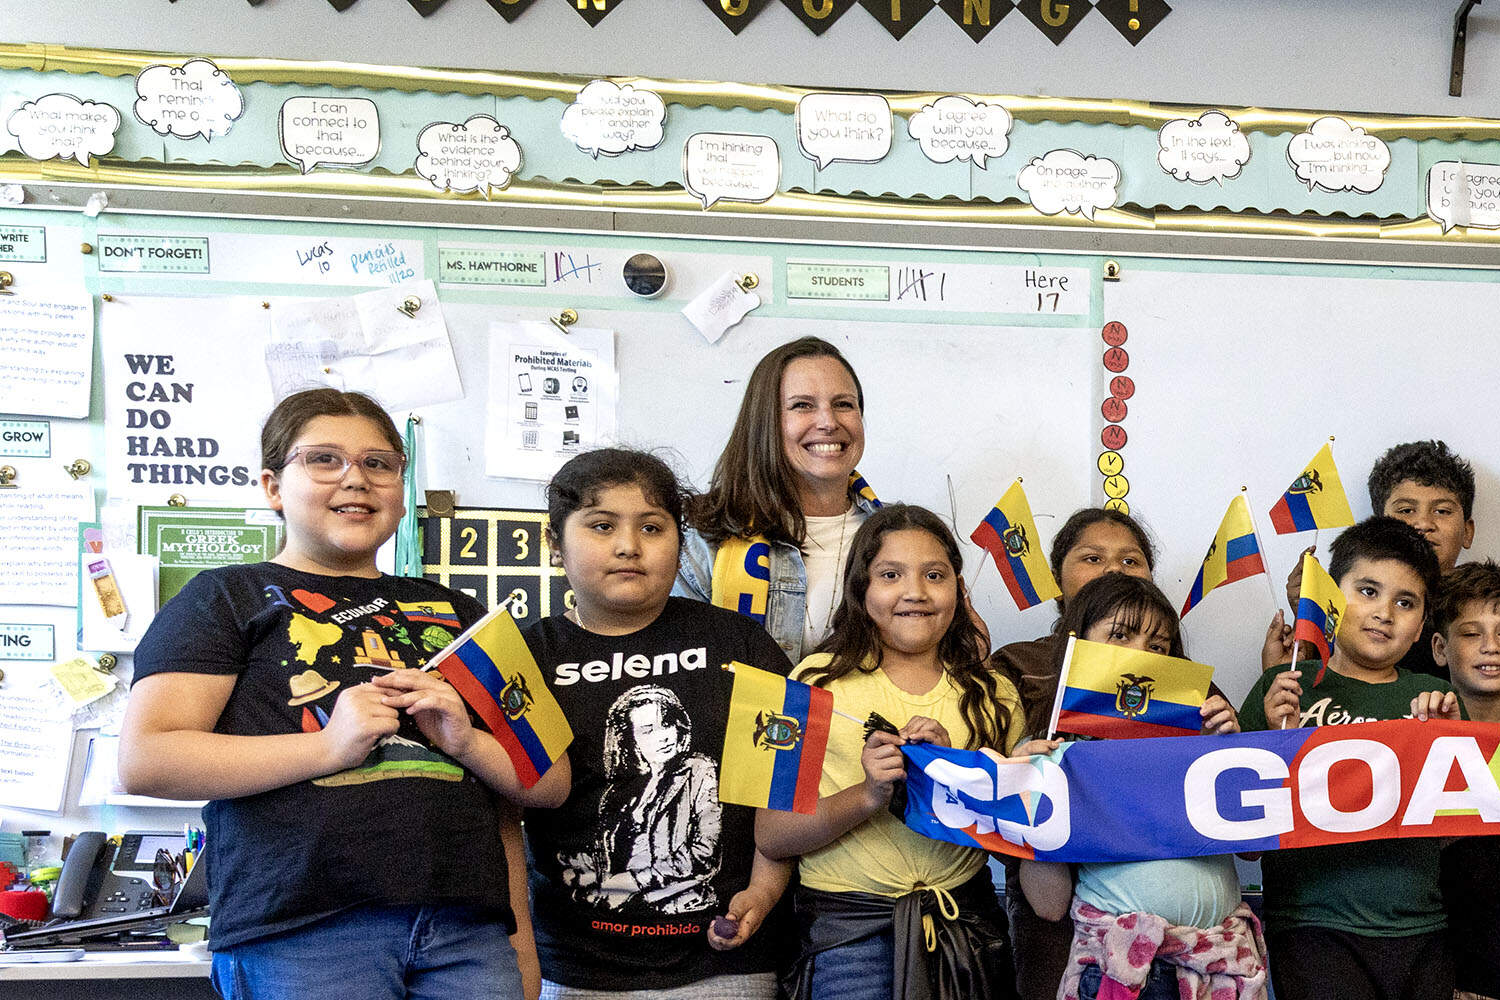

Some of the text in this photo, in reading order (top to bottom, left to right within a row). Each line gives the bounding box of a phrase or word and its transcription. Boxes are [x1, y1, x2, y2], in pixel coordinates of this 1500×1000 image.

[171, 78, 202, 91] That
[320, 103, 347, 114] can
[621, 97, 646, 108] you
[65, 112, 108, 123] makes
[161, 108, 186, 120] me
[617, 108, 655, 118] explain
[814, 110, 877, 124] What do
[948, 111, 987, 125] agree
[292, 116, 367, 129] connect to
[607, 119, 650, 129] another
[316, 130, 342, 141] that
[808, 125, 884, 141] you think?
[932, 123, 994, 139] with you
[438, 132, 499, 144] What the
[1171, 136, 1207, 147] In the
[295, 143, 365, 157] because...
[441, 145, 495, 156] evidence
[700, 139, 764, 157] I'm thinking
[430, 157, 506, 169] behind your
[706, 152, 728, 163] that
[1333, 151, 1382, 162] but now
[443, 169, 492, 181] thinking?
[1036, 165, 1089, 179] On page
[1475, 188, 1500, 200] you
[1, 233, 29, 243] WRITE
[104, 247, 202, 259] DON'T FORGET!
[295, 241, 334, 267] Lucas
[447, 260, 538, 273] MS. HAWTHORNE
[811, 275, 865, 287] STUDENTS
[1025, 270, 1069, 292] Here
[1036, 292, 1060, 312] 17
[1109, 324, 1121, 335] N
[124, 353, 175, 376] WE
[514, 354, 593, 368] Prohibited Materials
[126, 381, 194, 403] CAN
[126, 408, 171, 430] DO
[2, 431, 44, 442] GROW
[126, 436, 219, 458] HARD
[127, 463, 258, 486] THINGS.
[185, 535, 240, 545] GREEK
[460, 527, 529, 560] 2 3
[162, 543, 263, 553] MYTHOLOGY
[511, 588, 529, 619] 8
[331, 597, 390, 625] ECUADOR
[554, 647, 707, 686] selena
[591, 918, 700, 937] amor prohibido
